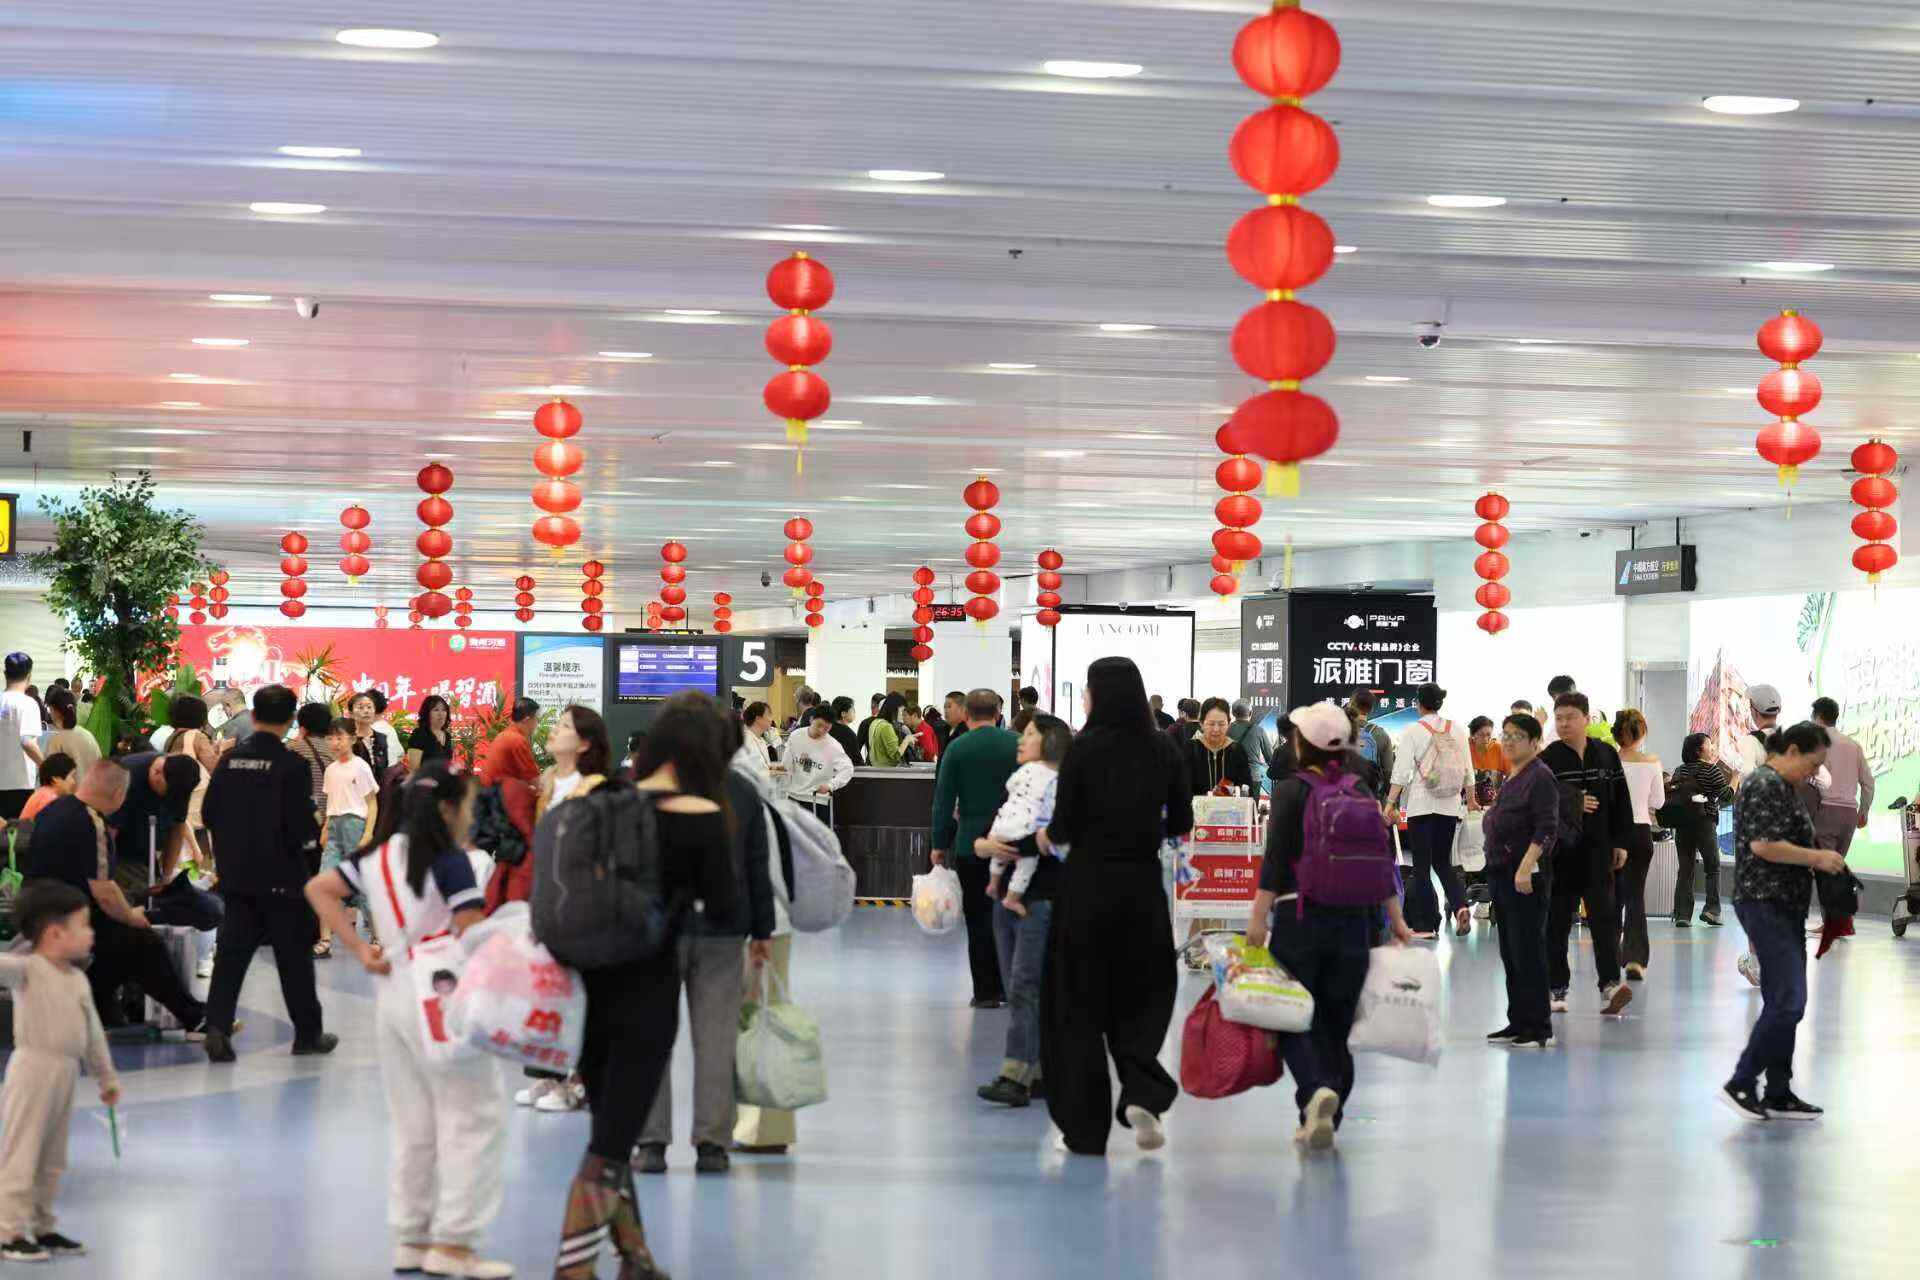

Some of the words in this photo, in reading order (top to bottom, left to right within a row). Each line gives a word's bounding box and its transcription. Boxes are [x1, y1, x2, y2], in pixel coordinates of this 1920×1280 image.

[543, 662, 581, 672] 温馨提示
[739, 641, 767, 682] 5
[1313, 658, 1433, 685] 派雅门窗
[229, 759, 273, 771] SECURITY
